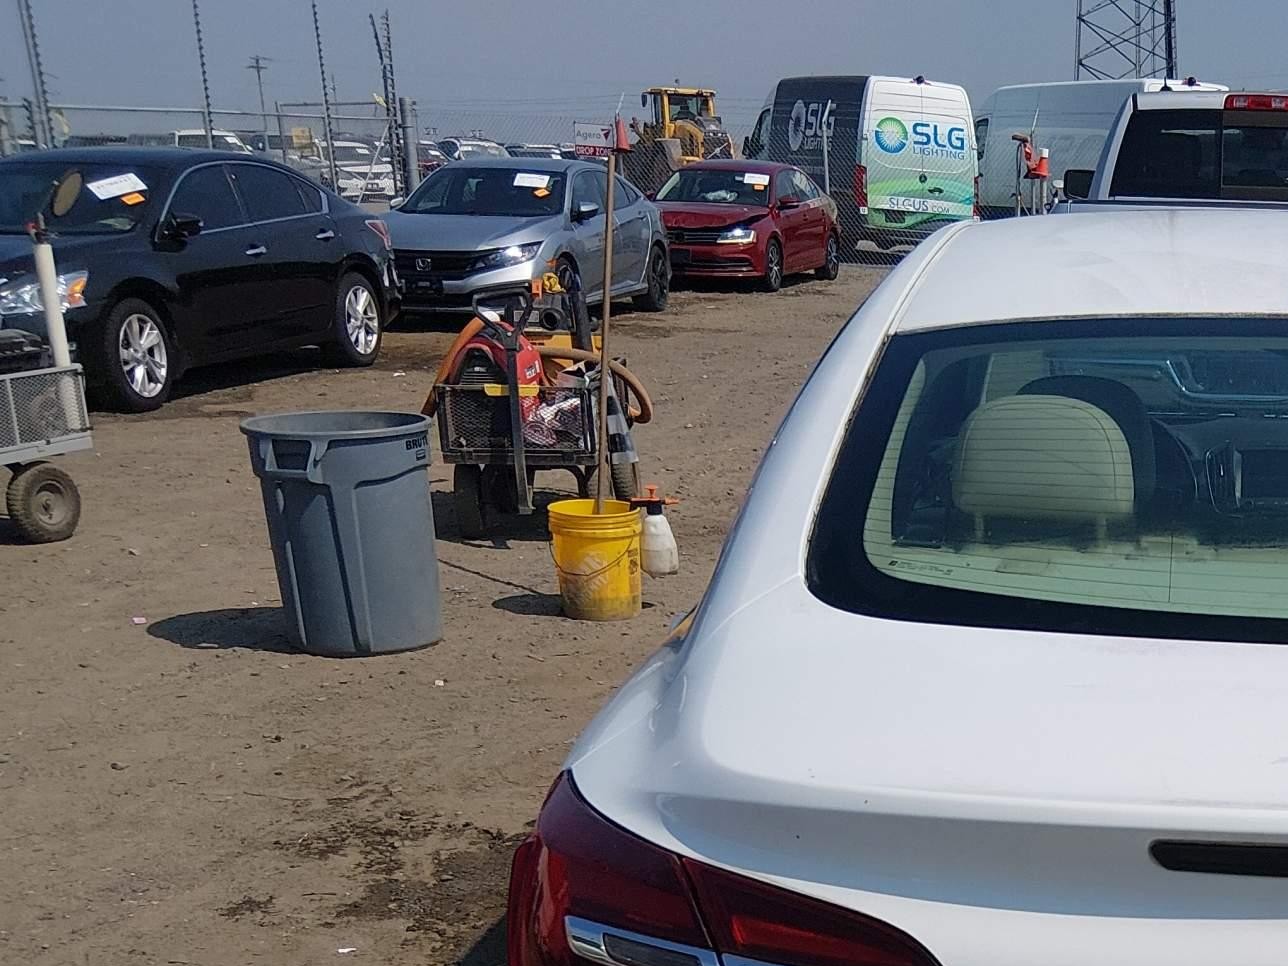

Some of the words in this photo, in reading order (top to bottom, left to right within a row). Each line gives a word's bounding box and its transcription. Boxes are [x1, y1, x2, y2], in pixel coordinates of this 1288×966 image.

[805, 103, 836, 137] SLG
[576, 129, 601, 141] Agero
[912, 122, 965, 151] SLG
[576, 146, 594, 156] DROP
[803, 137, 833, 151] LIGHTIG
[913, 146, 965, 161] LIGHTING
[405, 436, 428, 450] BRUT
